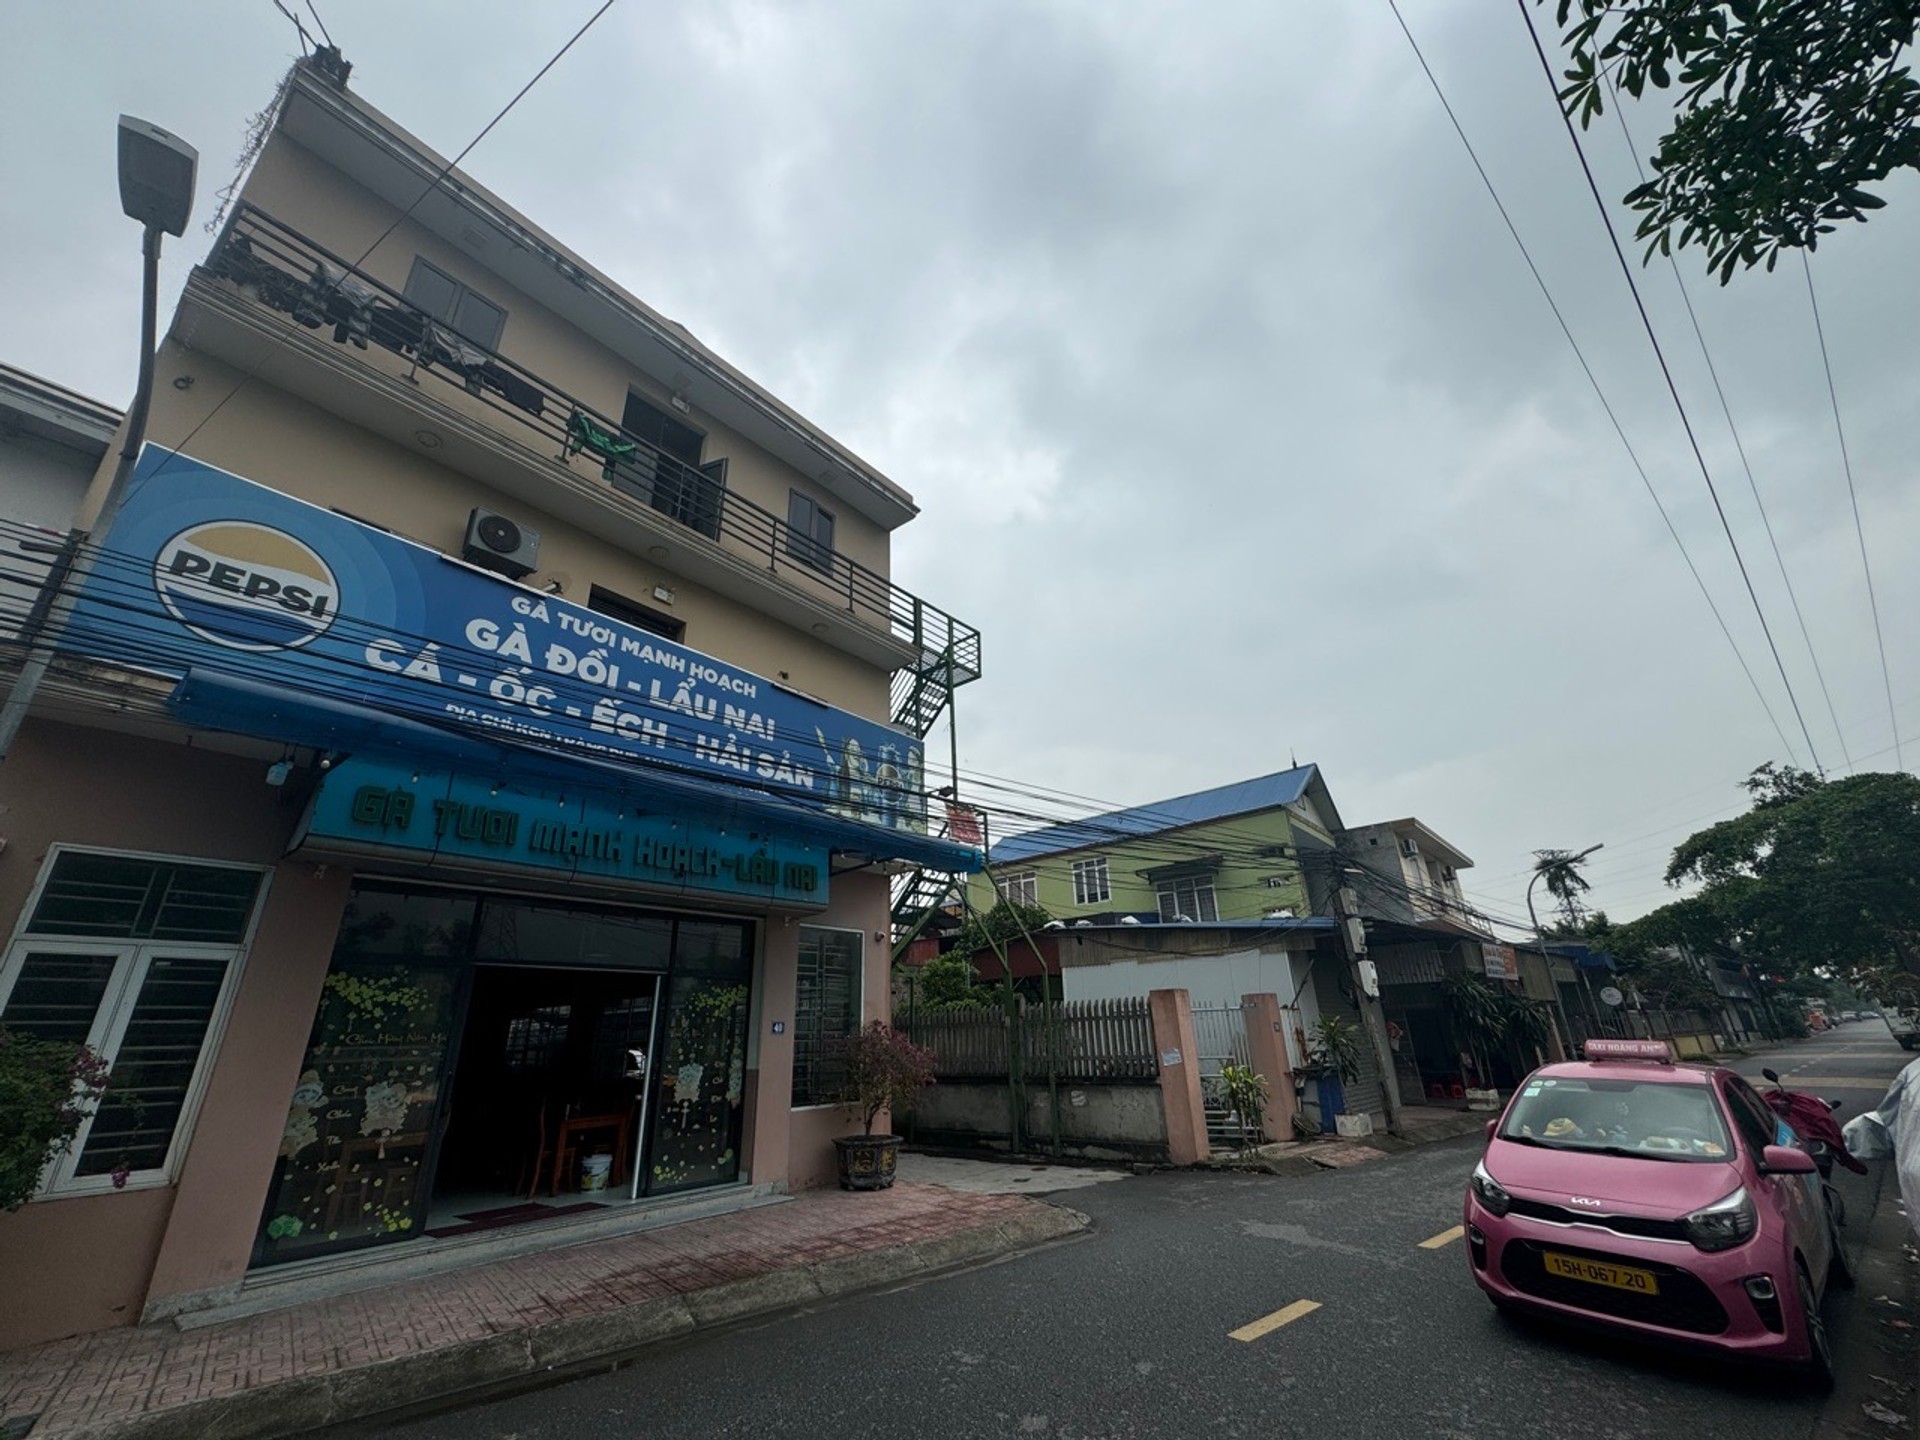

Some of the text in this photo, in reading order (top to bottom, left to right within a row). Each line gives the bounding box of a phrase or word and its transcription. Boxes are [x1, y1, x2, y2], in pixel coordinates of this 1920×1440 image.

[170, 550, 328, 618] PEPSI
[465, 618, 532, 664] GÀ
[545, 643, 619, 689] ĐỒI
[649, 678, 718, 721] LẨU
[723, 703, 776, 742] NAI
[511, 596, 757, 699] GÀ TƯƠI MẠNH HOẠCH
[365, 638, 443, 684] CÁ
[489, 666, 557, 717] ỐC
[590, 697, 668, 749] ẾCH
[695, 733, 751, 772] HẢI
[756, 750, 814, 790] SẢN
[353, 784, 415, 828] GÀ
[784, 861, 818, 892] NAI
[1588, 1042, 1606, 1051] TAXI
[1554, 1258, 1646, 1289] 15H-067.20
